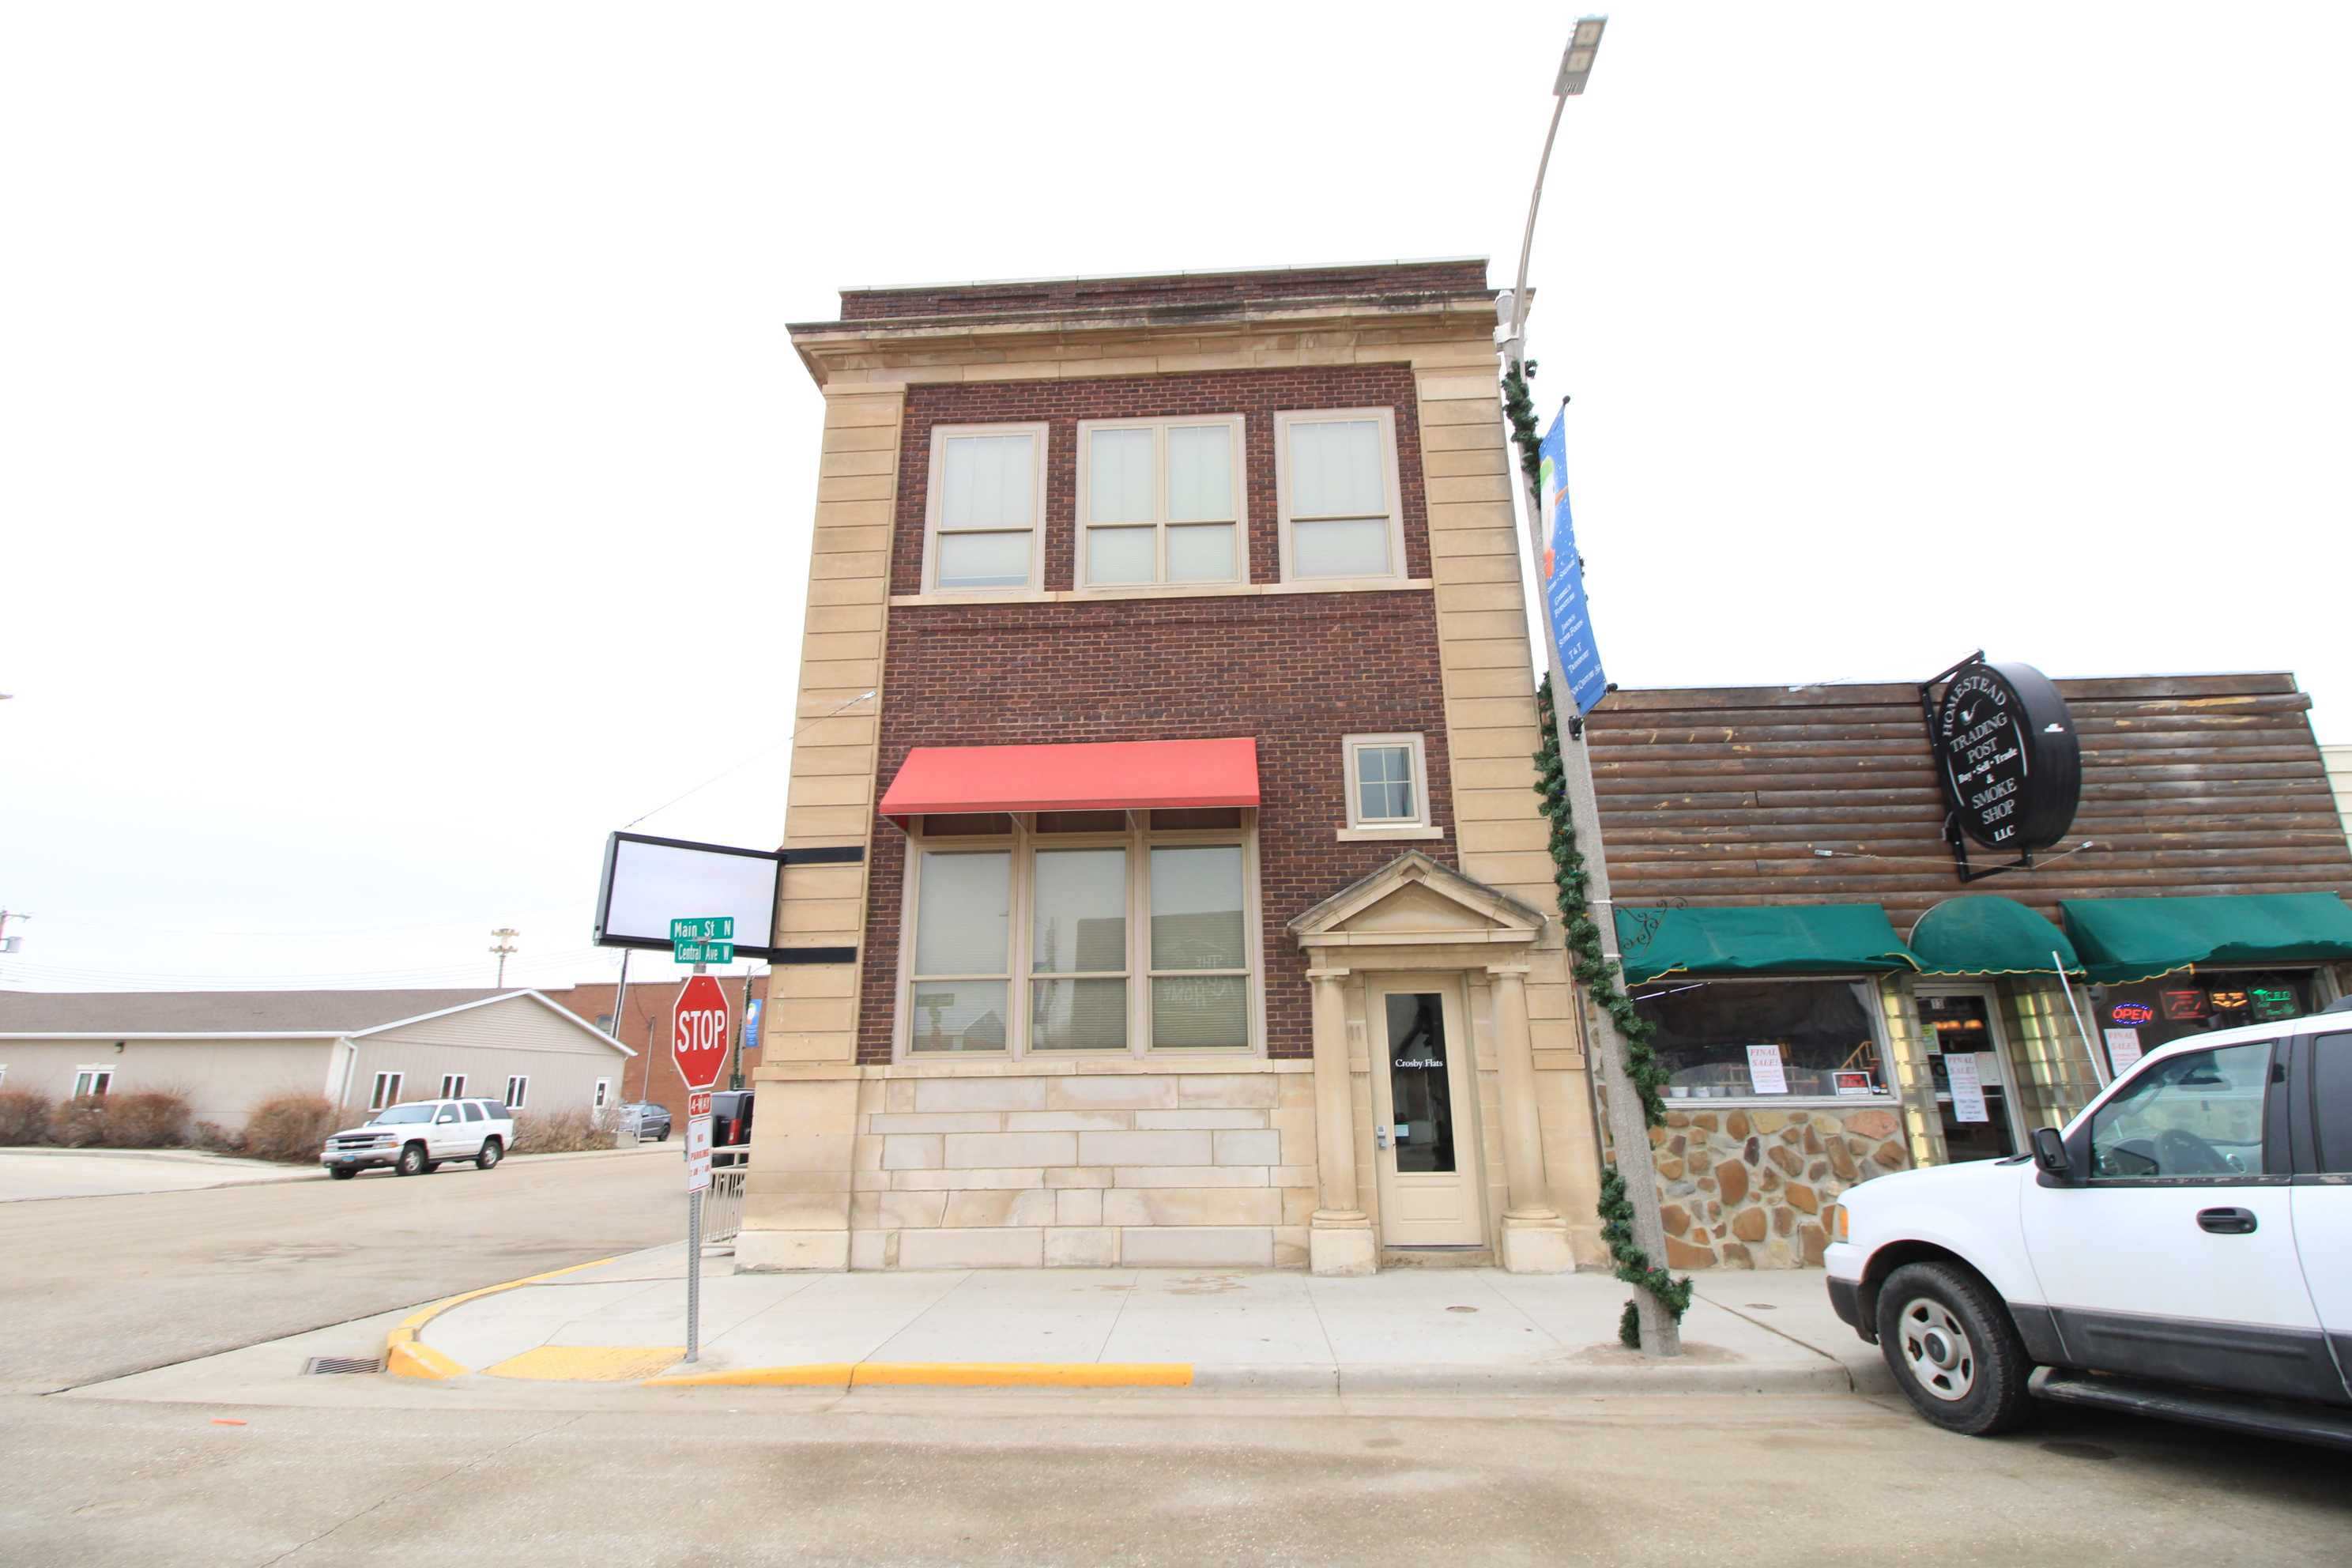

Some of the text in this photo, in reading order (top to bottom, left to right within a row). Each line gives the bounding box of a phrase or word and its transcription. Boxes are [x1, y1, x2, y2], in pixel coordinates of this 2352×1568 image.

[1943, 676, 2007, 737] HOMESTEAD
[1950, 712, 2007, 752] TRADING
[1966, 737, 1997, 764] POST
[1972, 778, 2018, 808] SMOKE
[1982, 799, 2015, 824] SHOP
[1994, 824, 2015, 842] LLC
[674, 920, 731, 937] Main St N
[678, 944, 729, 961] Central Ave W
[2113, 1008, 2154, 1020] OPEN
[677, 1009, 726, 1053] STOP
[1750, 1049, 1777, 1057] FINAL
[1947, 1055, 1974, 1064] FINAL
[1395, 1058, 1443, 1069] Crosby Flats
[692, 1097, 710, 1111] 4-WAY
